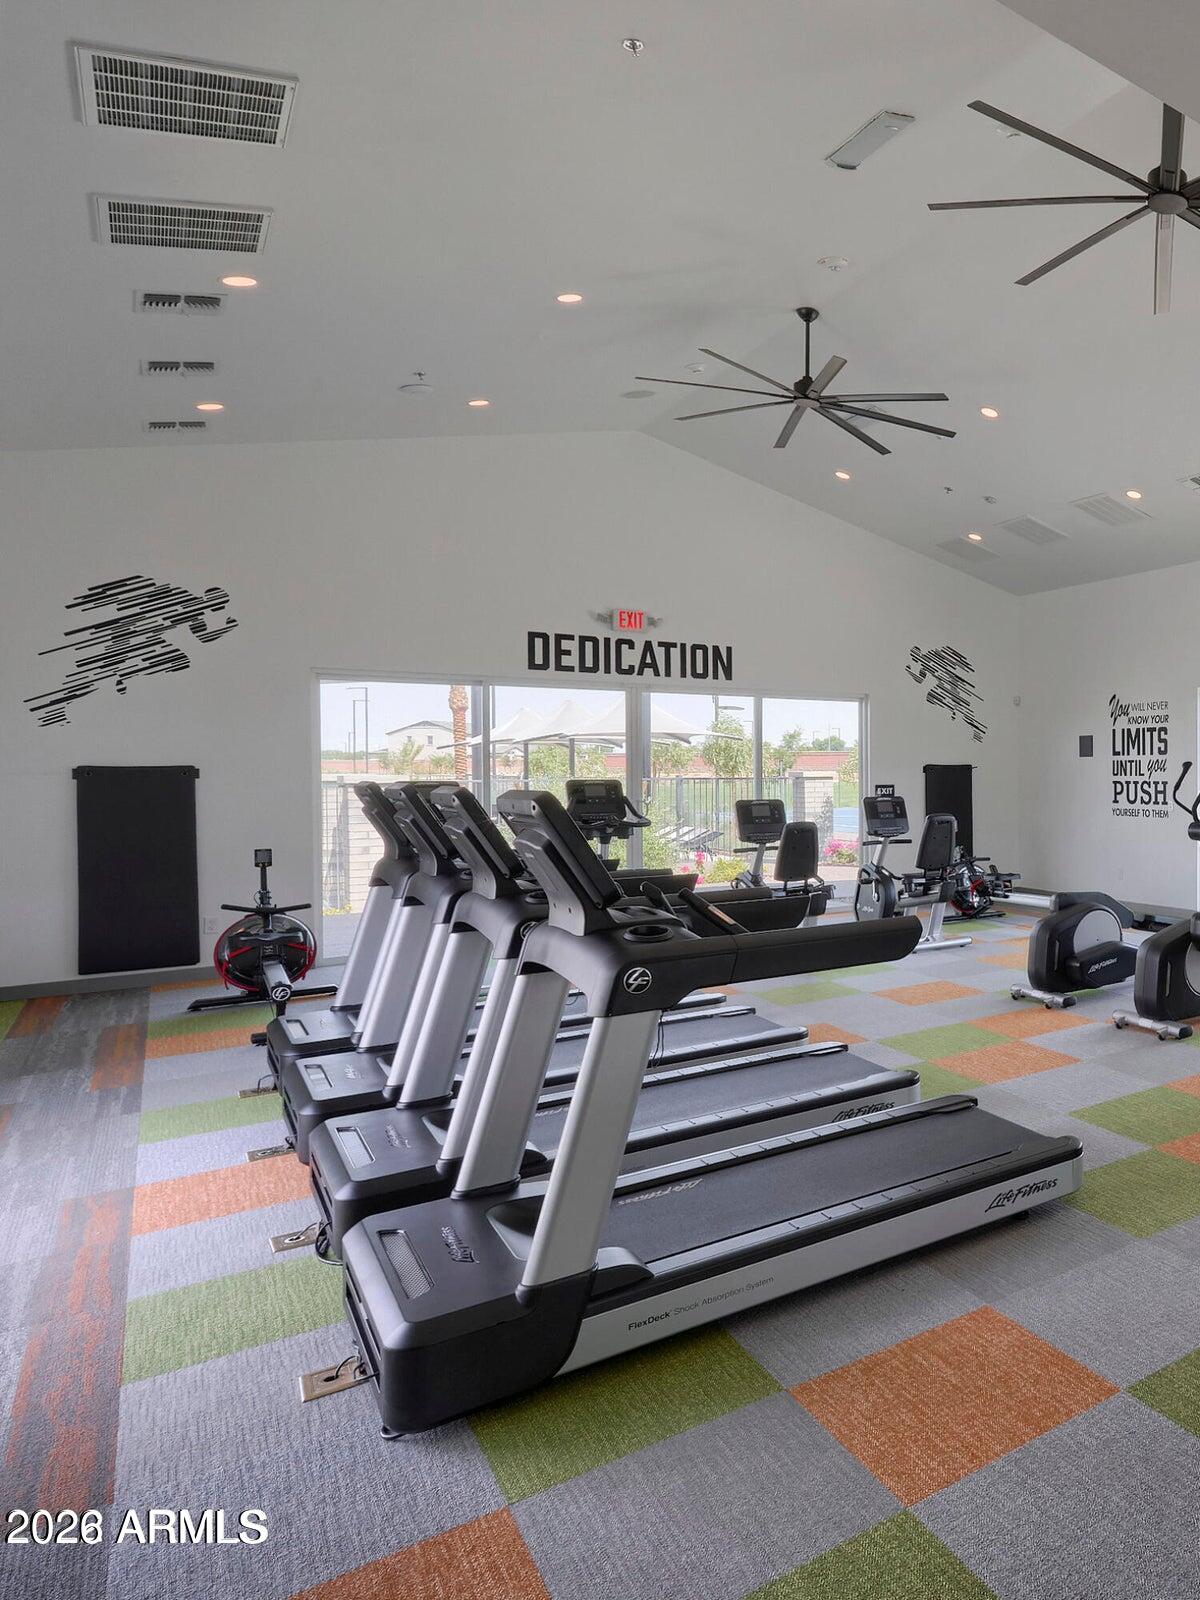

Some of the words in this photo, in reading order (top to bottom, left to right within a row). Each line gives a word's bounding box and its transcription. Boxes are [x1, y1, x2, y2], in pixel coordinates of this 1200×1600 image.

[618, 610, 644, 629] EXIT
[527, 631, 733, 681] DEDICATION
[1109, 694, 1130, 727] You
[1131, 703, 1145, 711] WILL
[1146, 701, 1168, 711] NEVER
[1128, 715, 1149, 725] KNOW
[1150, 714, 1169, 724] YOUR
[1112, 726, 1168, 756] LIMITS
[1112, 759, 1145, 777] UNTIL
[1147, 759, 1167, 780] you
[1112, 780, 1168, 805] PUSH
[1112, 808, 1140, 817] YOURSELF
[1142, 809, 1151, 818] TO
[1151, 809, 1169, 818] THEM
[628, 1311, 671, 1331] FlexDeck
[674, 1302, 699, 1316] Shock
[701, 1286, 745, 1308] Absorption
[745, 1276, 775, 1293] System
